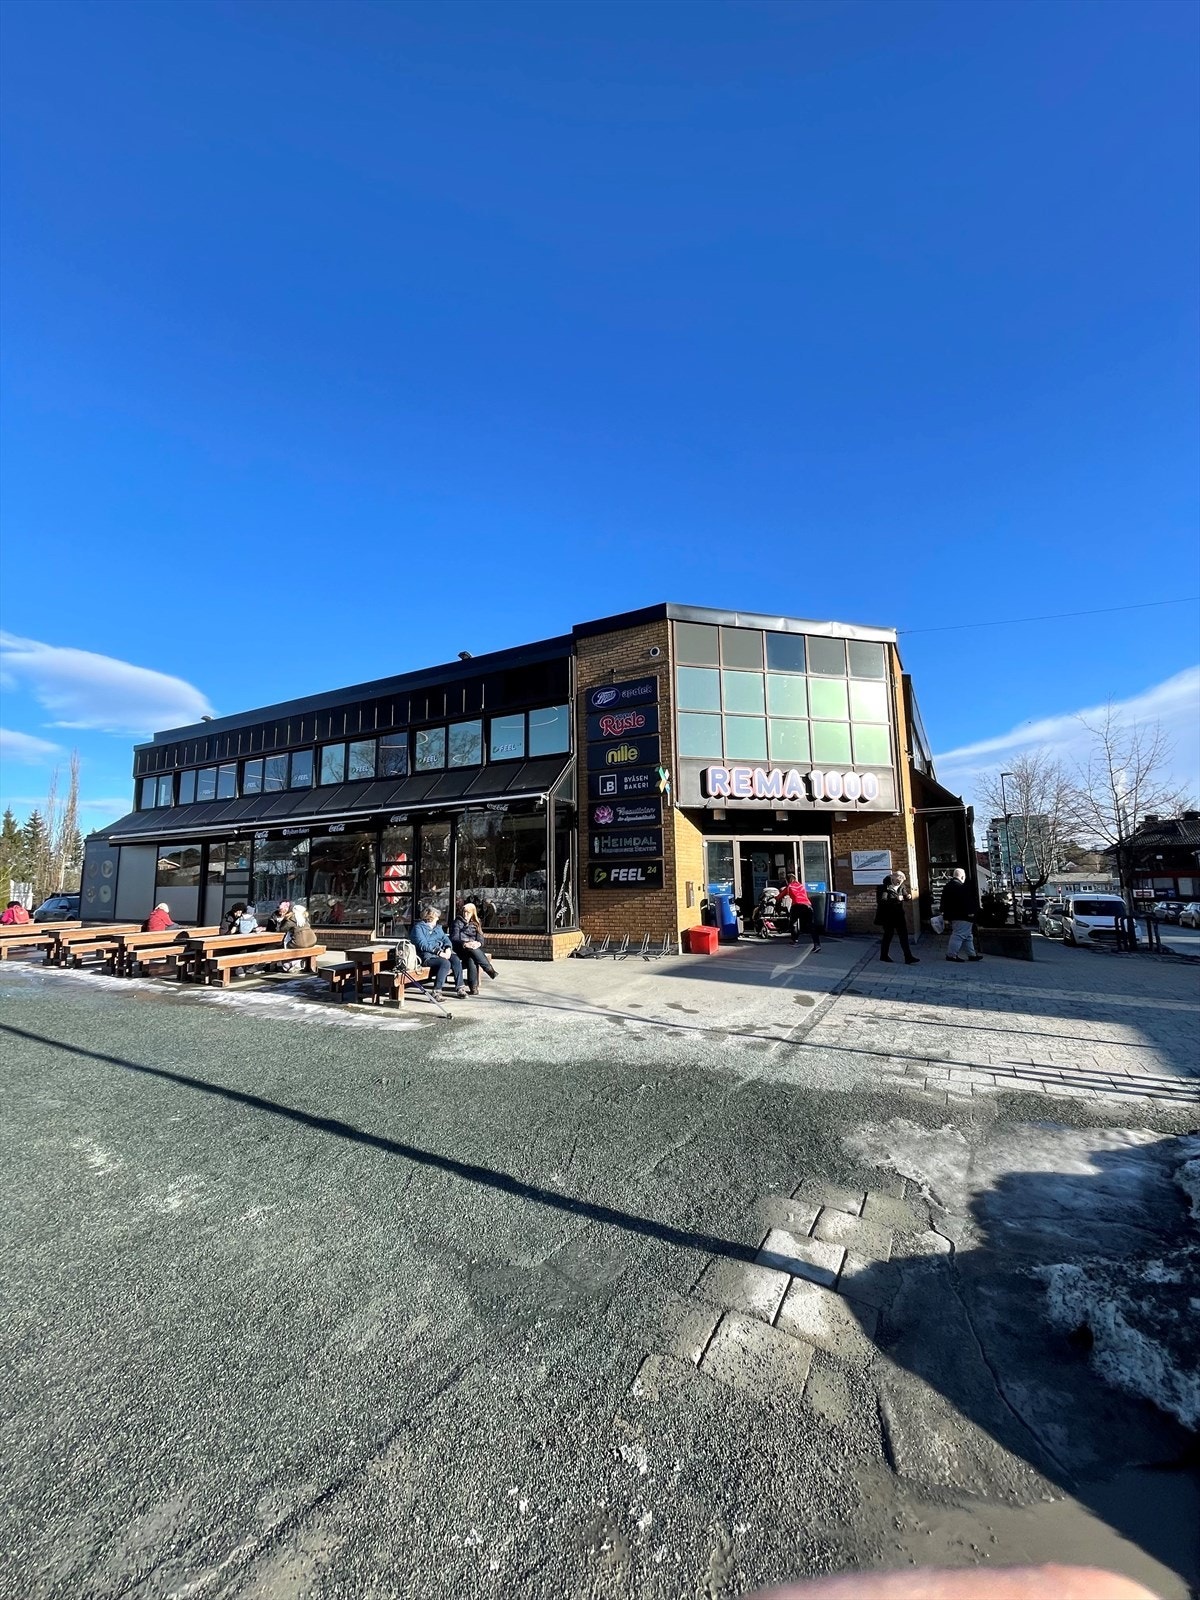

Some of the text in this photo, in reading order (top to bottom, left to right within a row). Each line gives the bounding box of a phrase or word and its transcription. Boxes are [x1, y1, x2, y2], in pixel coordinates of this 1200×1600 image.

[499, 744, 517, 752] FEEL
[607, 744, 638, 764] nille
[623, 775, 649, 783] BYÅSEN
[707, 766, 879, 801] REMA 1000
[623, 782, 649, 790] BAKERI
[601, 836, 657, 848] HEIMDAL
[610, 866, 657, 881] FEEL 24
